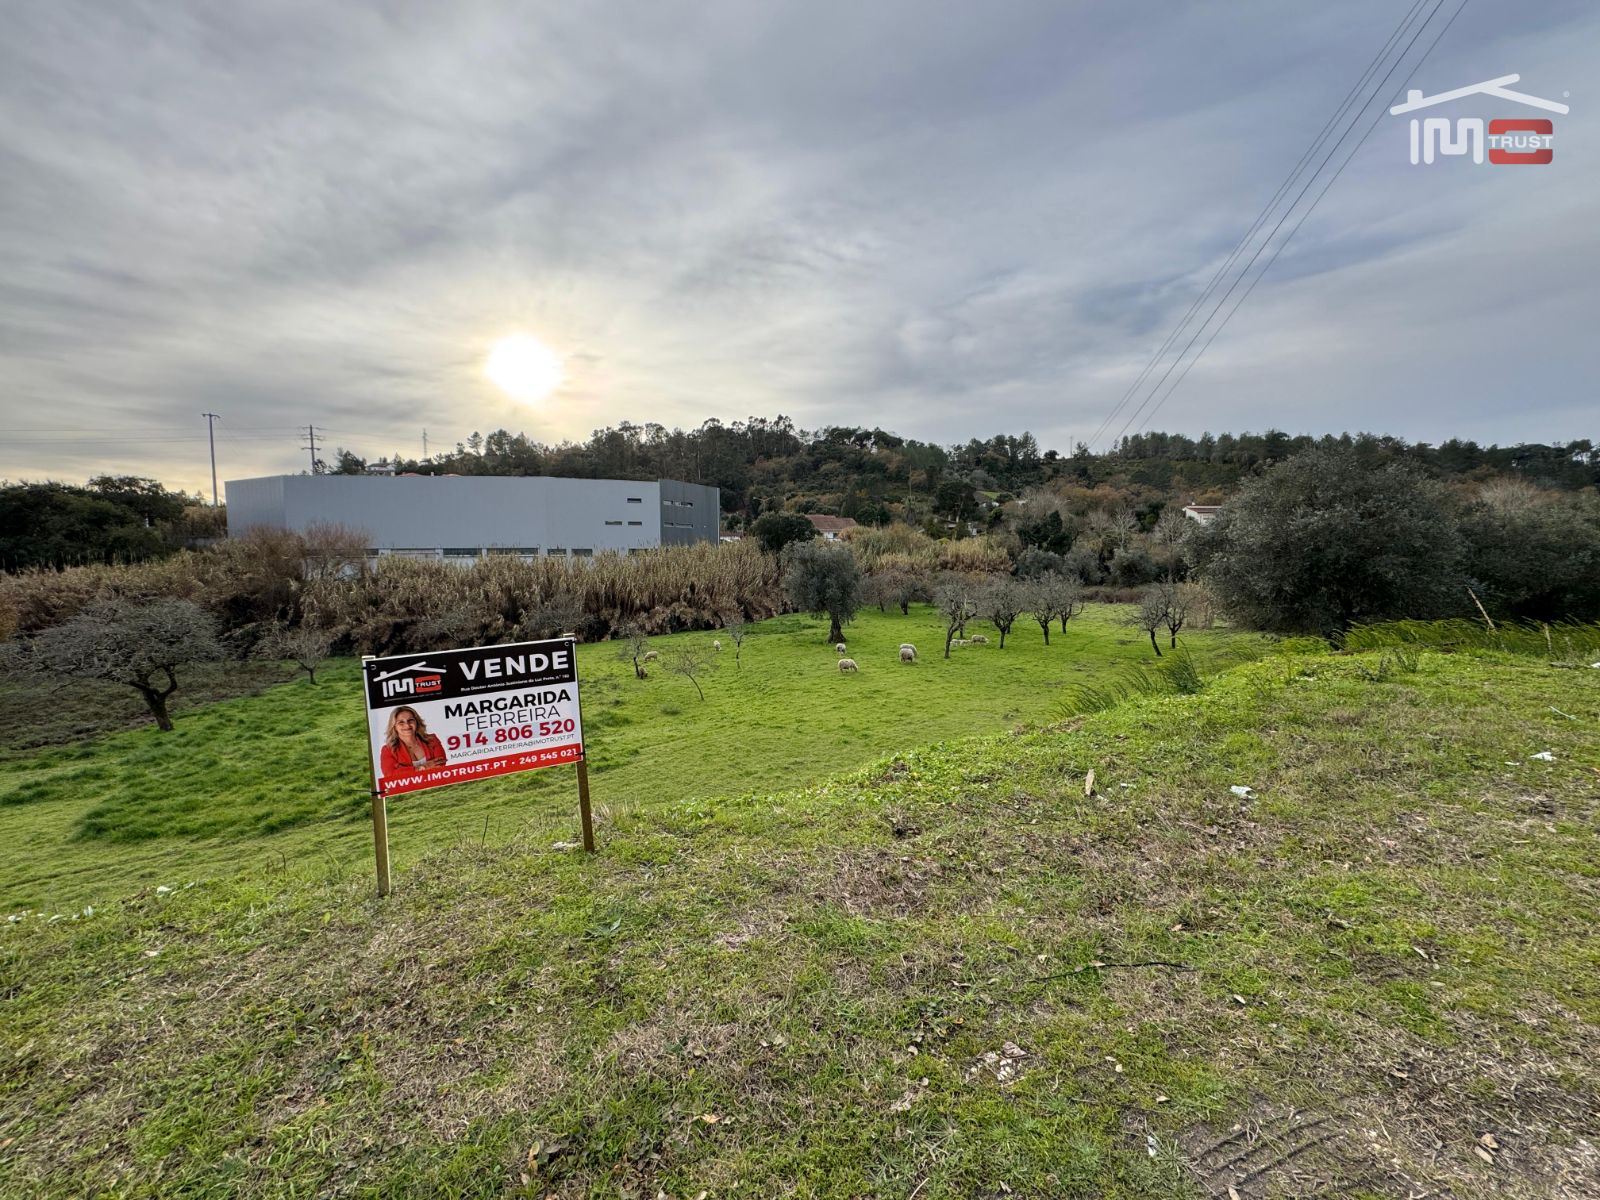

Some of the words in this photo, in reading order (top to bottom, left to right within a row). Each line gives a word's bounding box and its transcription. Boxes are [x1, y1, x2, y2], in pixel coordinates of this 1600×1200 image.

[458, 650, 569, 681] VENDE
[415, 679, 441, 688] TRUST
[444, 689, 572, 719] MARGARIDA
[465, 705, 561, 732] FERREIRA
[447, 731, 489, 751] 914
[494, 724, 533, 744] 806
[539, 718, 575, 737] 520
[450, 733, 575, 760] MARGARIDA.FERREIRA@IMOTRUST.PT
[384, 760, 508, 789] WWW.IMOTRUST.PT
[519, 755, 538, 765] 249
[540, 752, 558, 761] 545
[560, 748, 577, 758] 021
